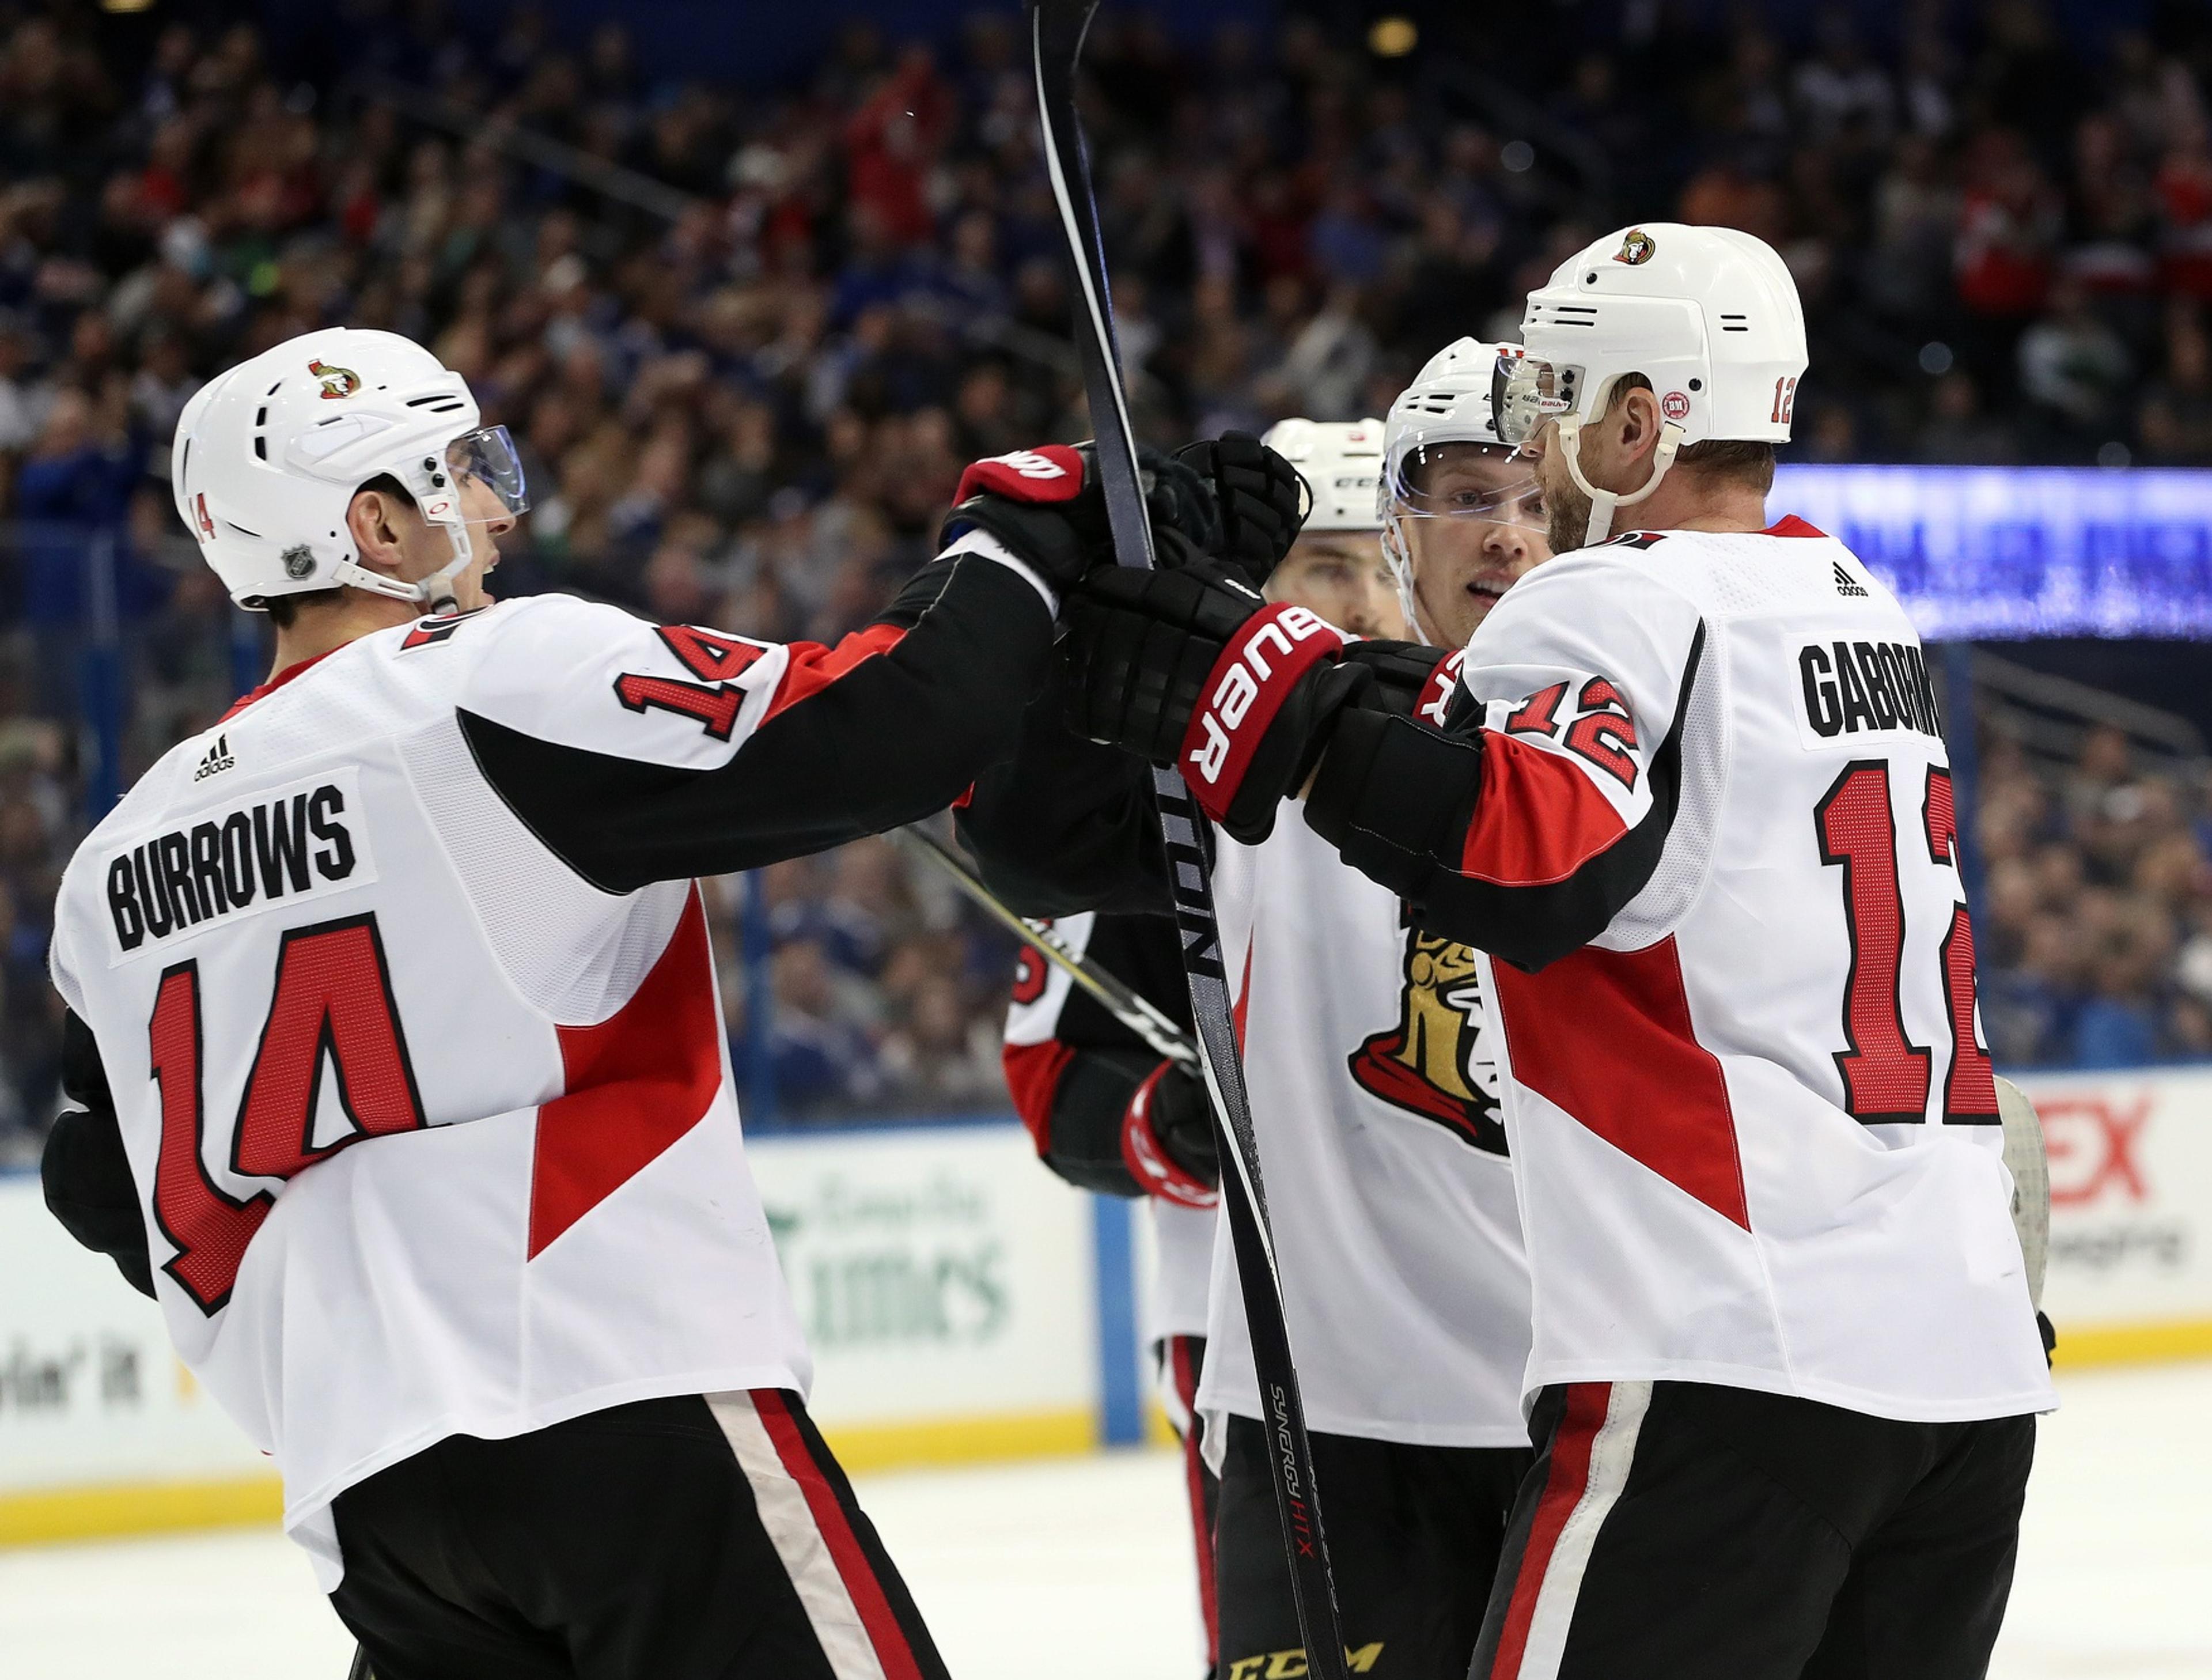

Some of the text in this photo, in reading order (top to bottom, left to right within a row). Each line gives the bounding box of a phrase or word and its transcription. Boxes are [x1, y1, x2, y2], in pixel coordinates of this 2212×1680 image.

[1771, 376, 1796, 424] 12
[1335, 476, 1382, 489] CC
[1837, 586, 1869, 597] adidas
[613, 625, 768, 743] 14
[1504, 675, 1640, 795] 12
[194, 756, 234, 781] adidas
[107, 784, 356, 952] BURROWS
[149, 910, 429, 1319] 14
[1271, 1383, 1316, 1559] SYNERGY HTX
